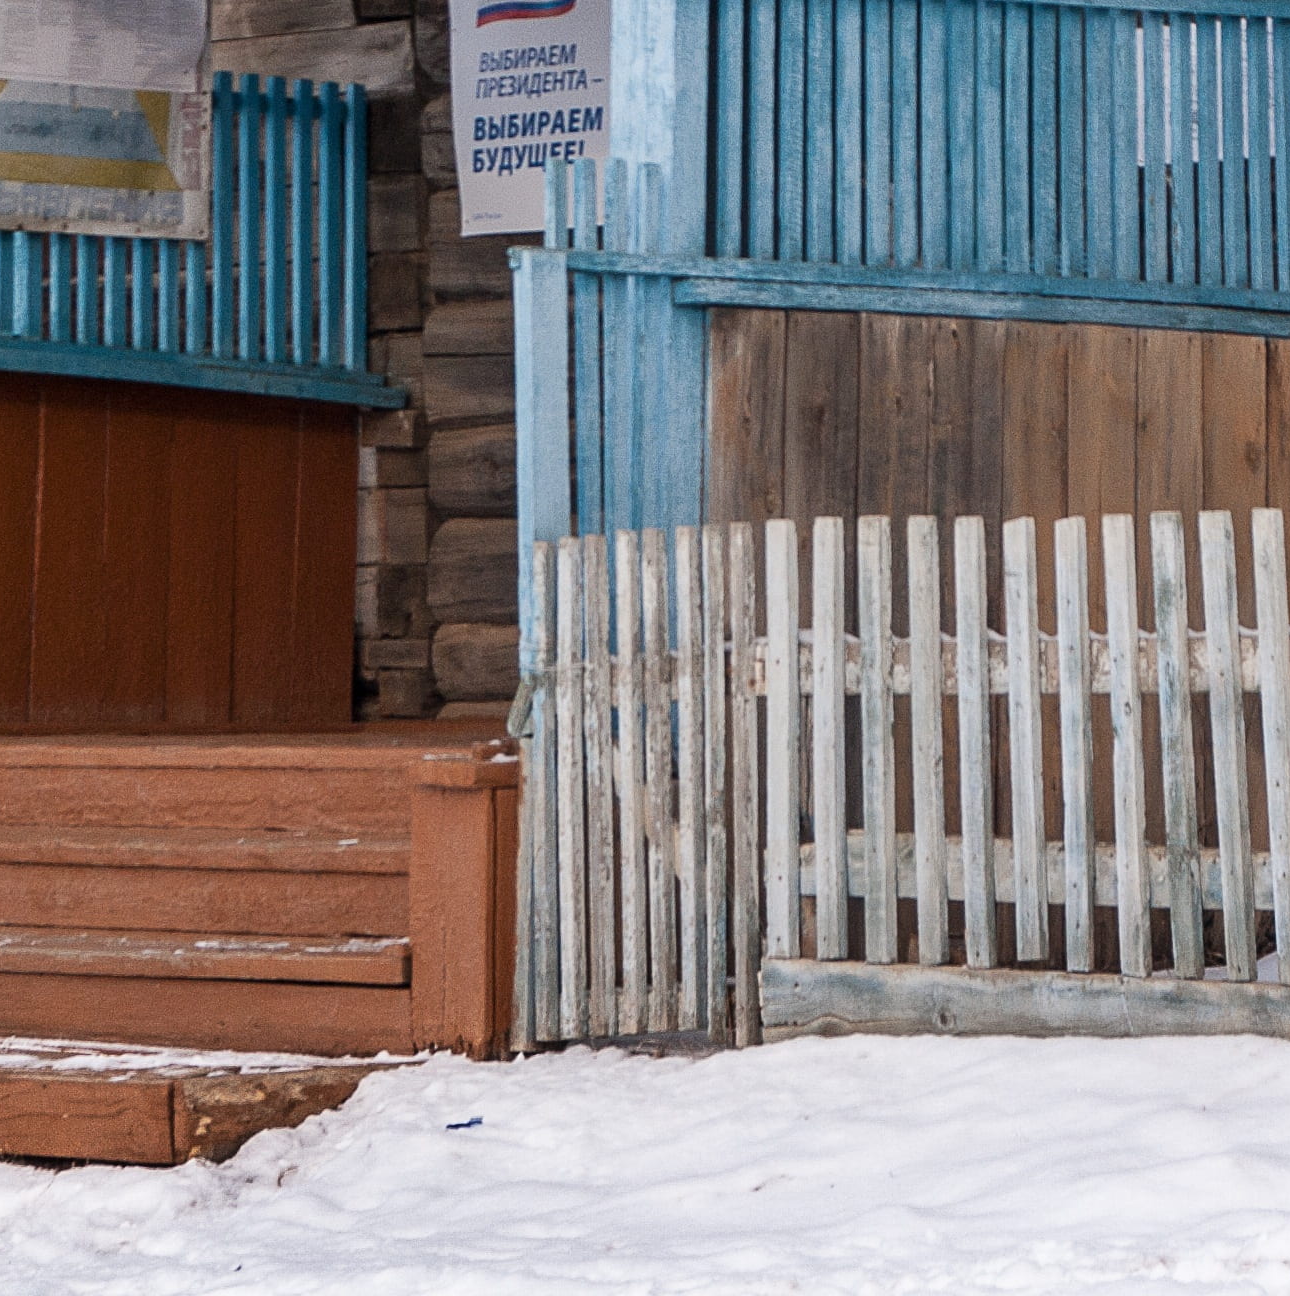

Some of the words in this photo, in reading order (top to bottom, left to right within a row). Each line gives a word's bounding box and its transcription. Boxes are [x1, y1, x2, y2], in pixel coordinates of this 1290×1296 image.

[478, 43, 577, 72] ВЫБИРАЕМ
[475, 69, 587, 98] ПРЕЗИДЕНТА
[473, 106, 604, 141] ВЫБИРАЕМ
